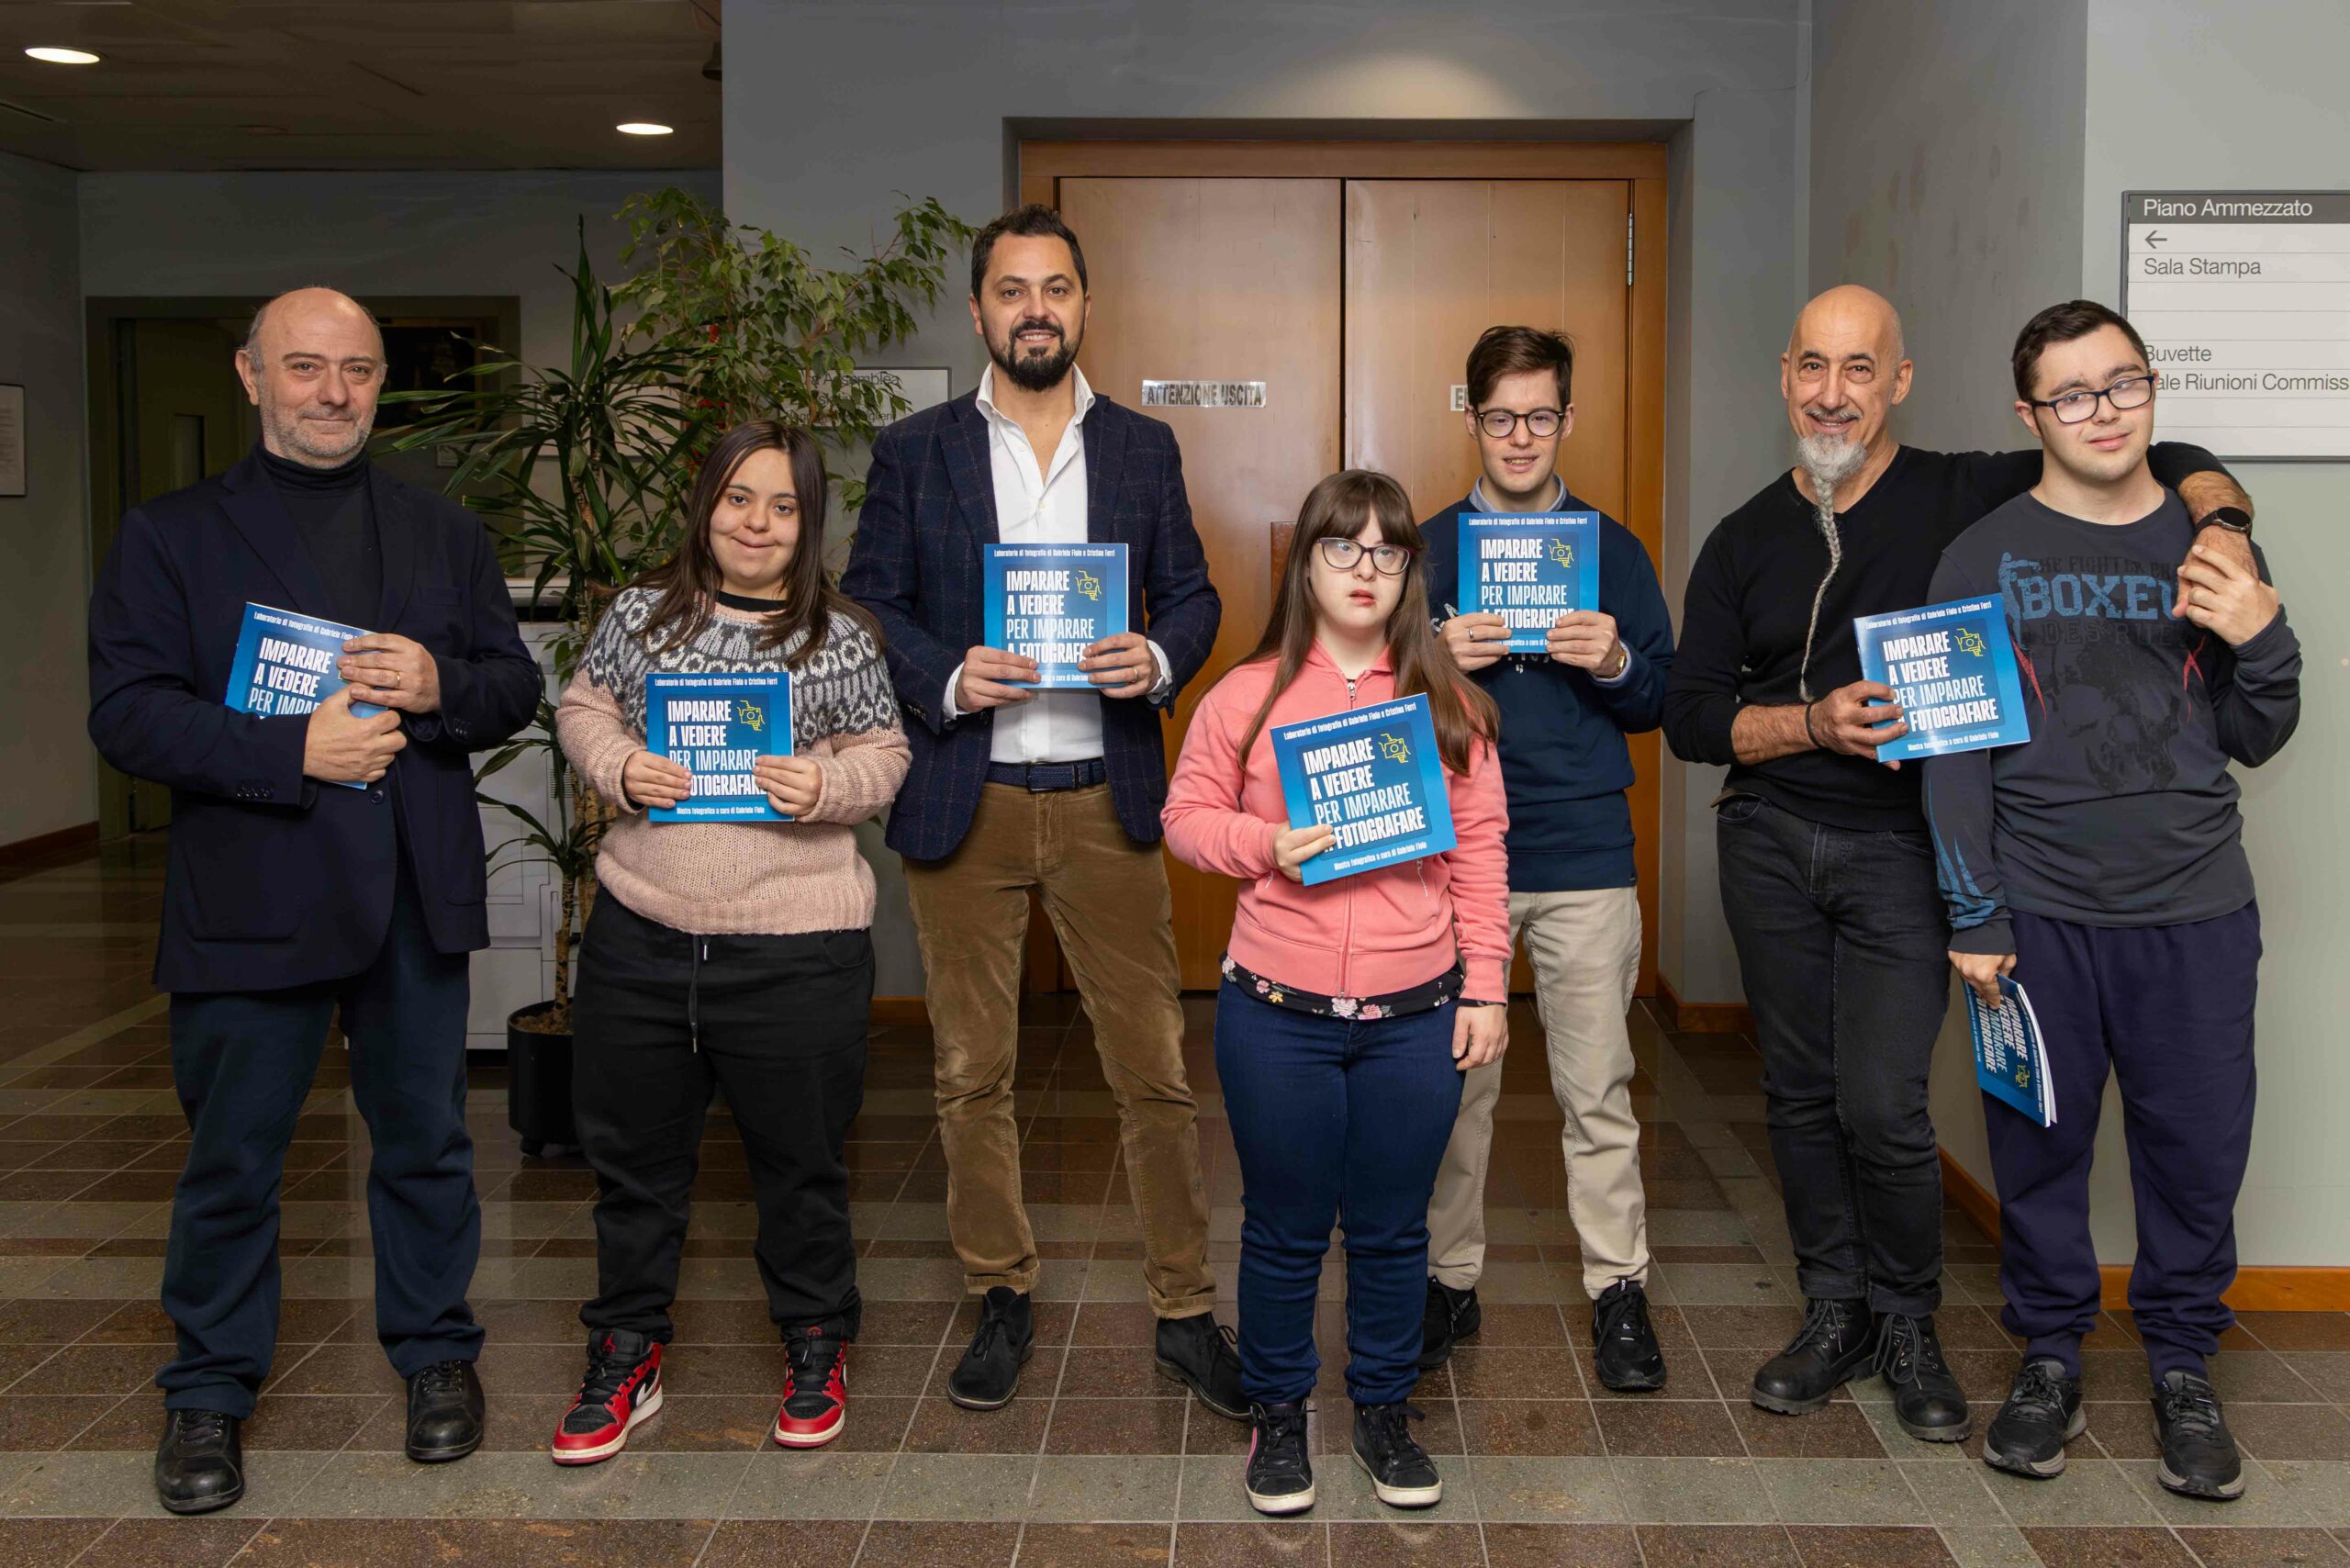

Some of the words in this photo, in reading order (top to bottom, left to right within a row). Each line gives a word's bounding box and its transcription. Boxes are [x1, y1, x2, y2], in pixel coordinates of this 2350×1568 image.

[2143, 198, 2196, 217] Piano
[2201, 199, 2312, 217] Ammezzato
[2143, 258, 2184, 274] Sala
[2189, 257, 2262, 279] Stampa
[2144, 345, 2212, 362] Buvette
[2155, 374, 2180, 390] ale
[2186, 374, 2257, 390] Riunioni
[1147, 384, 1217, 406] ATTENZIONE
[1221, 384, 1262, 406] USCITA
[1469, 518, 1493, 526] Laboratorio
[1498, 518, 1520, 527] fotografia
[994, 549, 1018, 557] Laboratorio
[1024, 549, 1046, 558] fotografia
[1053, 549, 1071, 557] Gabriele
[1087, 549, 1104, 557] Cristina
[1481, 539, 1543, 559] IMPARARE
[1006, 570, 1070, 592] IMPARARE
[1482, 562, 1490, 582] A
[1494, 562, 1538, 582] VEDERE
[1007, 594, 1015, 615] A
[1019, 594, 1065, 615] VEDERE
[1482, 585, 1503, 606] PER
[1507, 585, 1567, 605] IMPARARE
[2018, 574, 2181, 622] BOXEU
[253, 611, 282, 625] Laboratorio
[288, 620, 314, 633] fotografia
[1897, 614, 1921, 624] fotografia
[1920, 612, 1927, 621] di
[1926, 610, 1946, 619] Gabriele
[1962, 602, 1980, 612] Cristina
[1006, 618, 1029, 640] PER
[1034, 618, 1094, 639] IMPARARE
[2114, 622, 2179, 646] RUE
[259, 637, 334, 674] IMPARARE
[1020, 643, 1092, 664] FOTOGRAFA
[1883, 631, 1952, 662] IMPARARE
[253, 663, 265, 685] A
[267, 666, 321, 698] VEDERE
[1888, 665, 1899, 686] A
[1900, 655, 1951, 684] VEDERE
[655, 678, 678, 687] Laboratorio
[685, 678, 707, 688] fotografia
[713, 678, 732, 686] Gabriele
[748, 678, 767, 686] Cristina
[1919, 675, 1986, 704] IMPARARE
[247, 687, 274, 713] PER
[667, 700, 732, 722] IMPARARE
[1283, 729, 1312, 740] Laboratorio
[1311, 725, 1317, 734] di
[1317, 721, 1343, 733] fotografia
[1342, 718, 1348, 727] di
[1348, 713, 1369, 725] Gabriele
[1385, 706, 1404, 717] Cristina
[1909, 699, 1999, 733] FOTOGRAFARE
[669, 725, 677, 747] A
[680, 725, 727, 747] VEDERE
[1968, 733, 1987, 743] Gabriele
[696, 749, 758, 771] IMPARARE
[1303, 737, 1376, 775] IMPARARE
[1310, 778, 1323, 801] A
[1323, 765, 1375, 797] VEDERE
[1315, 803, 1342, 825] PER
[1344, 782, 1413, 820] IMPARARE
[1334, 806, 1426, 849] FOTOGRAFARE
[1334, 861, 1350, 871] Mostra
[1350, 855, 1376, 867] fotografica
[1380, 851, 1392, 859] cura
[1391, 848, 1396, 857] di
[1396, 844, 1416, 856] Gabriele
[1975, 995, 1998, 1073] OTOGRAFARE
[1999, 1003, 2016, 1050] VEDERE
[2004, 996, 2029, 1061] IMPARARE
[1989, 1010, 2008, 1073] IMPARARE
